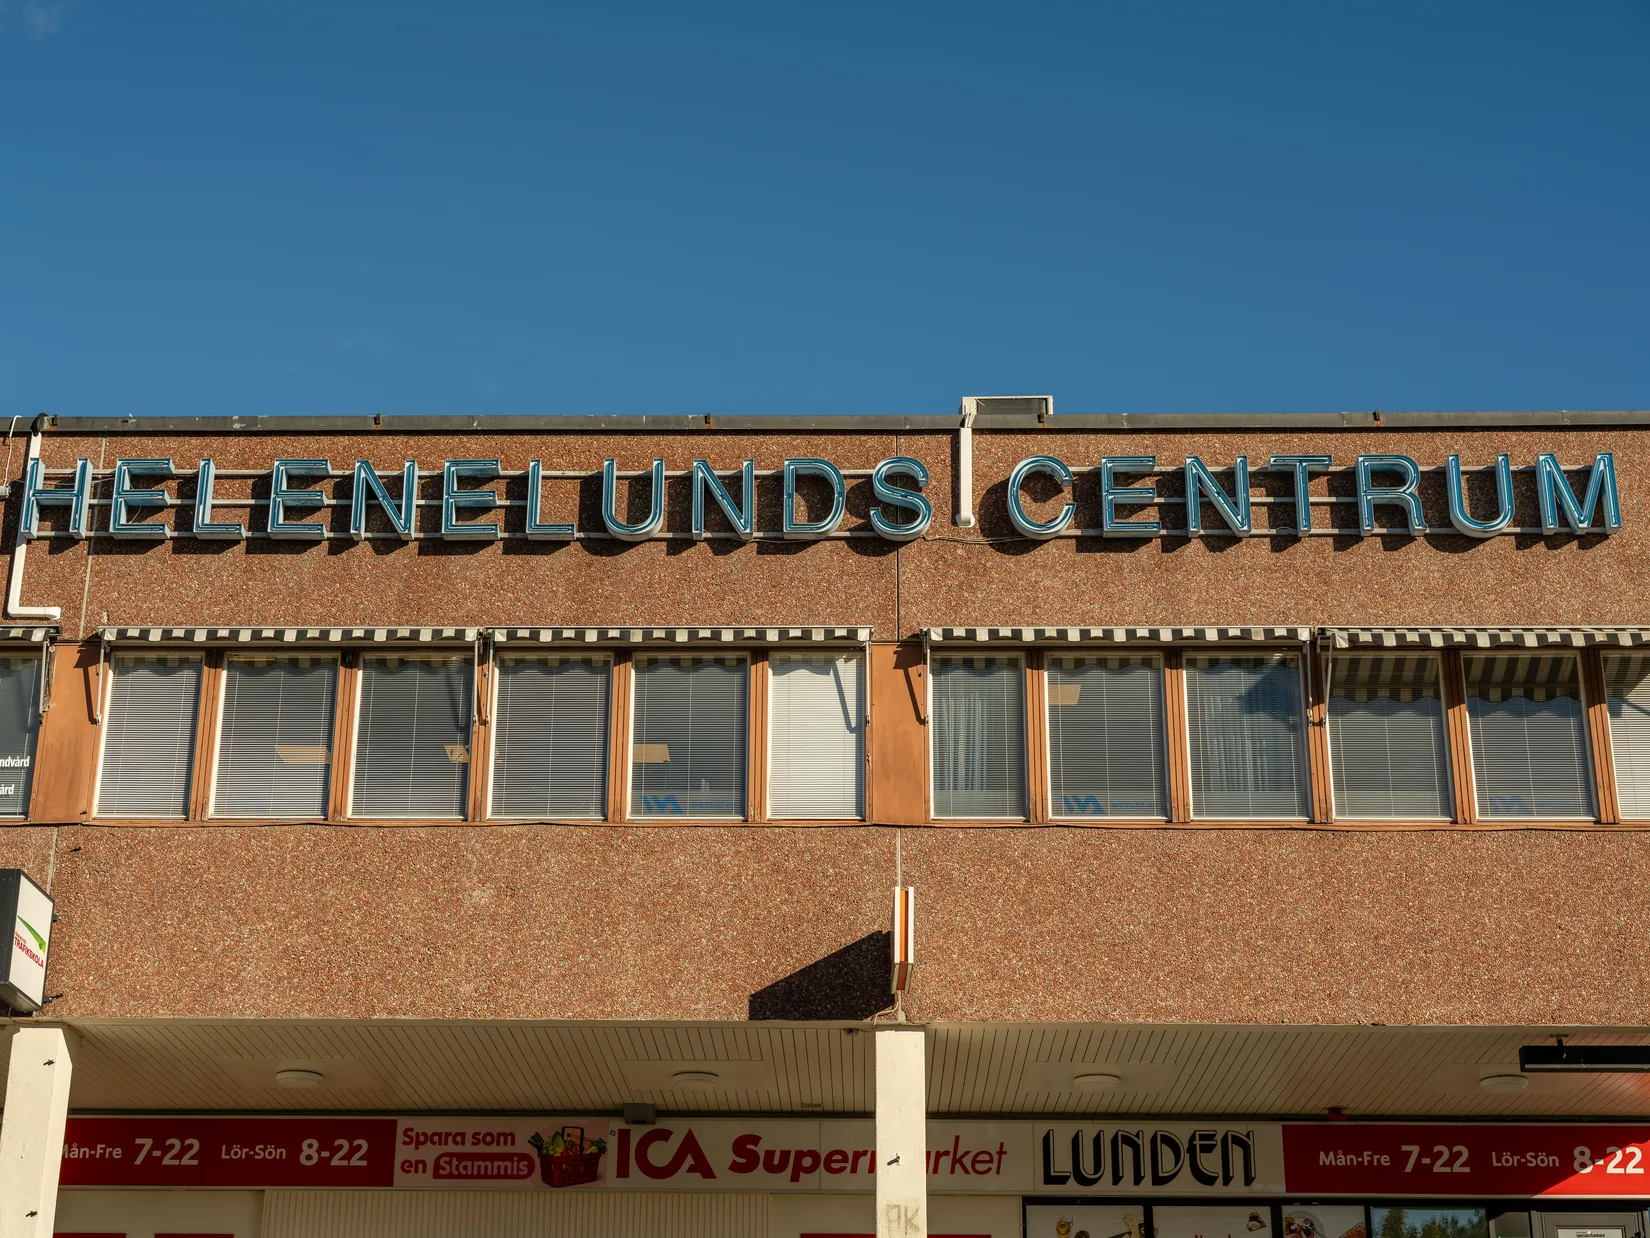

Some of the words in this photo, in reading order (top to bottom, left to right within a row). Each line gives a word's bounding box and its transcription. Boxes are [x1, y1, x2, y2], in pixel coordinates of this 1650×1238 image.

[20, 456, 932, 542] HELENELUNDS
[1007, 452, 1622, 540] CENTRUM
[14, 936, 44, 969] TRAFIKSKOLA
[133, 1138, 201, 1165] 7-22
[221, 1144, 286, 1160] Lör-Sön
[299, 1138, 369, 1166] 8-22
[402, 1127, 466, 1150] Spara
[471, 1131, 516, 1146] som
[400, 1158, 427, 1174] en
[438, 1156, 528, 1175] Stammis
[616, 1128, 717, 1179] ICA
[728, 1134, 1007, 1182] Superrket
[1042, 1129, 1257, 1187] LUNDEN
[1319, 1150, 1391, 1167] Mån-Fre
[1401, 1145, 1471, 1173] 7-22
[1492, 1150, 1560, 1168] Lör-Sön
[1573, 1146, 1645, 1175] 8-22
